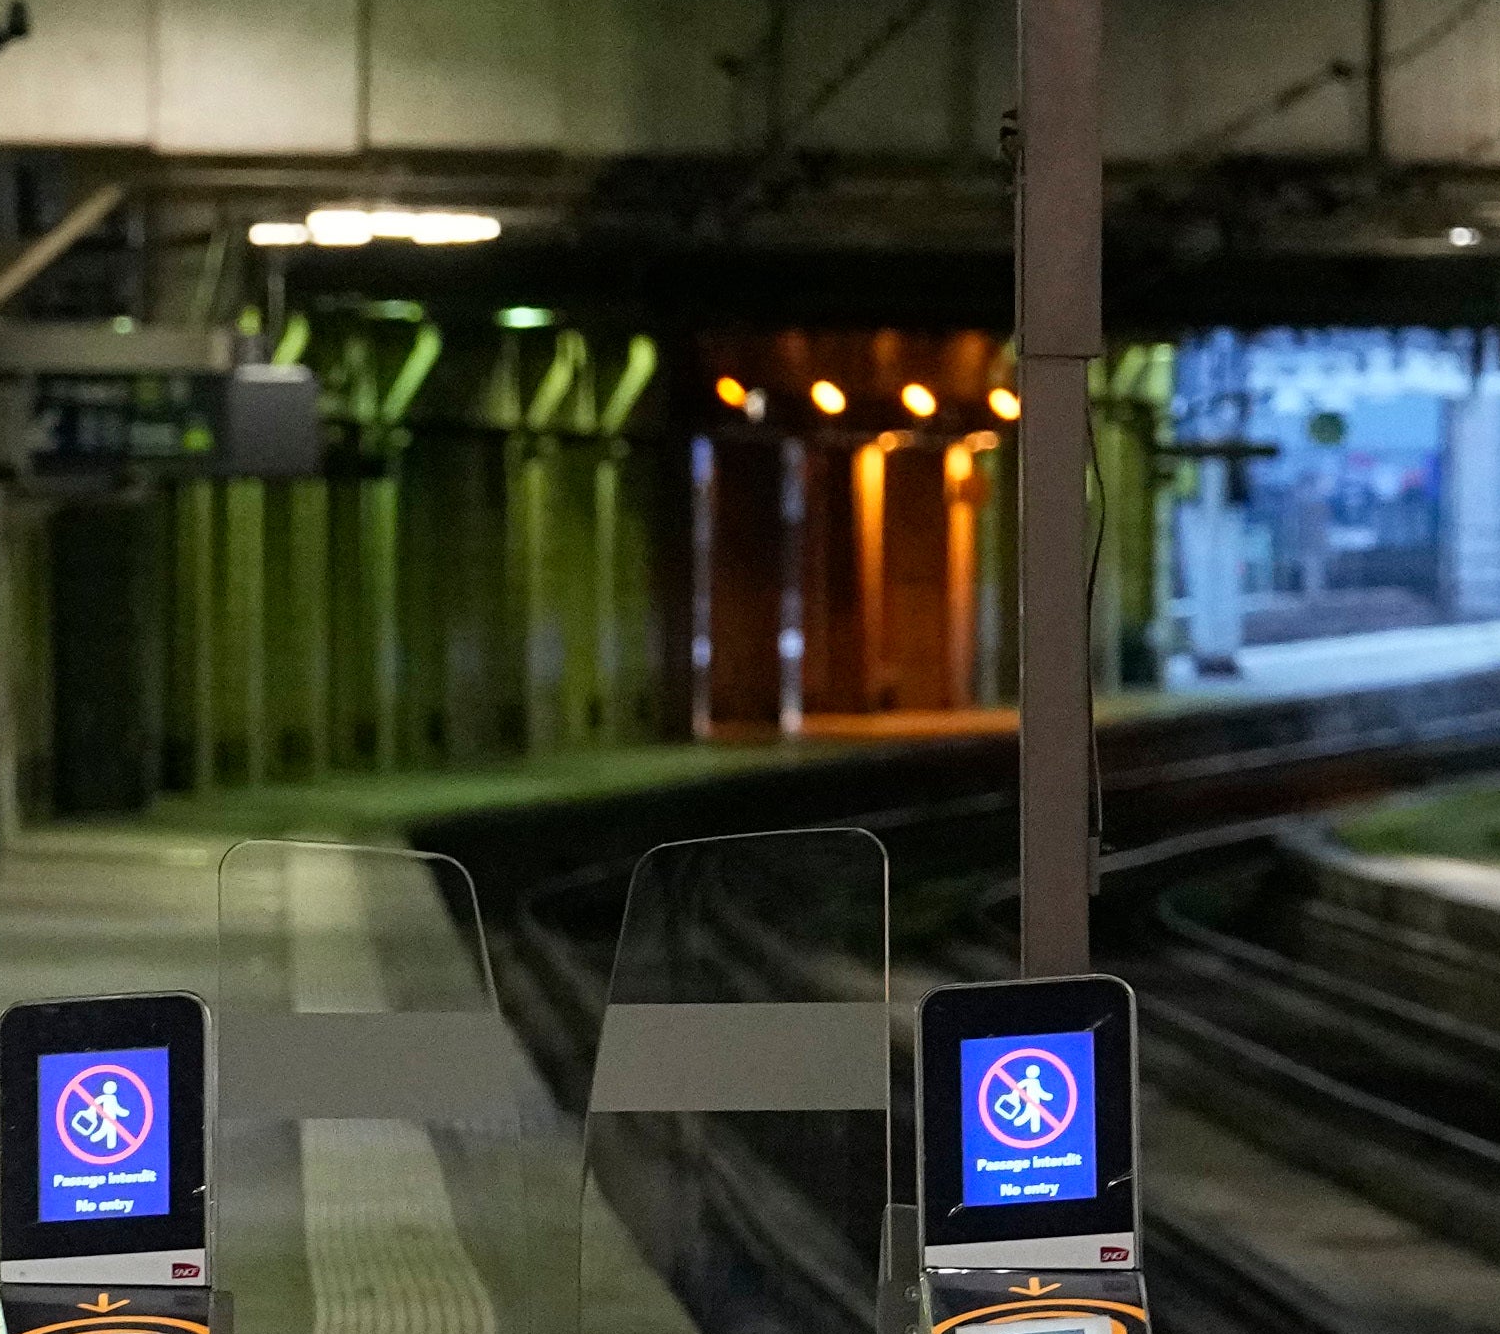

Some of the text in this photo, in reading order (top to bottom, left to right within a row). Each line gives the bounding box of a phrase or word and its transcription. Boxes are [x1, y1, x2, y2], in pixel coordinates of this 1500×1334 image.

[976, 1152, 1083, 1173] Passage interdit
[53, 1168, 157, 1189] Passage interdit
[999, 1182, 1060, 1197] No entry
[75, 1198, 135, 1214] No entry
